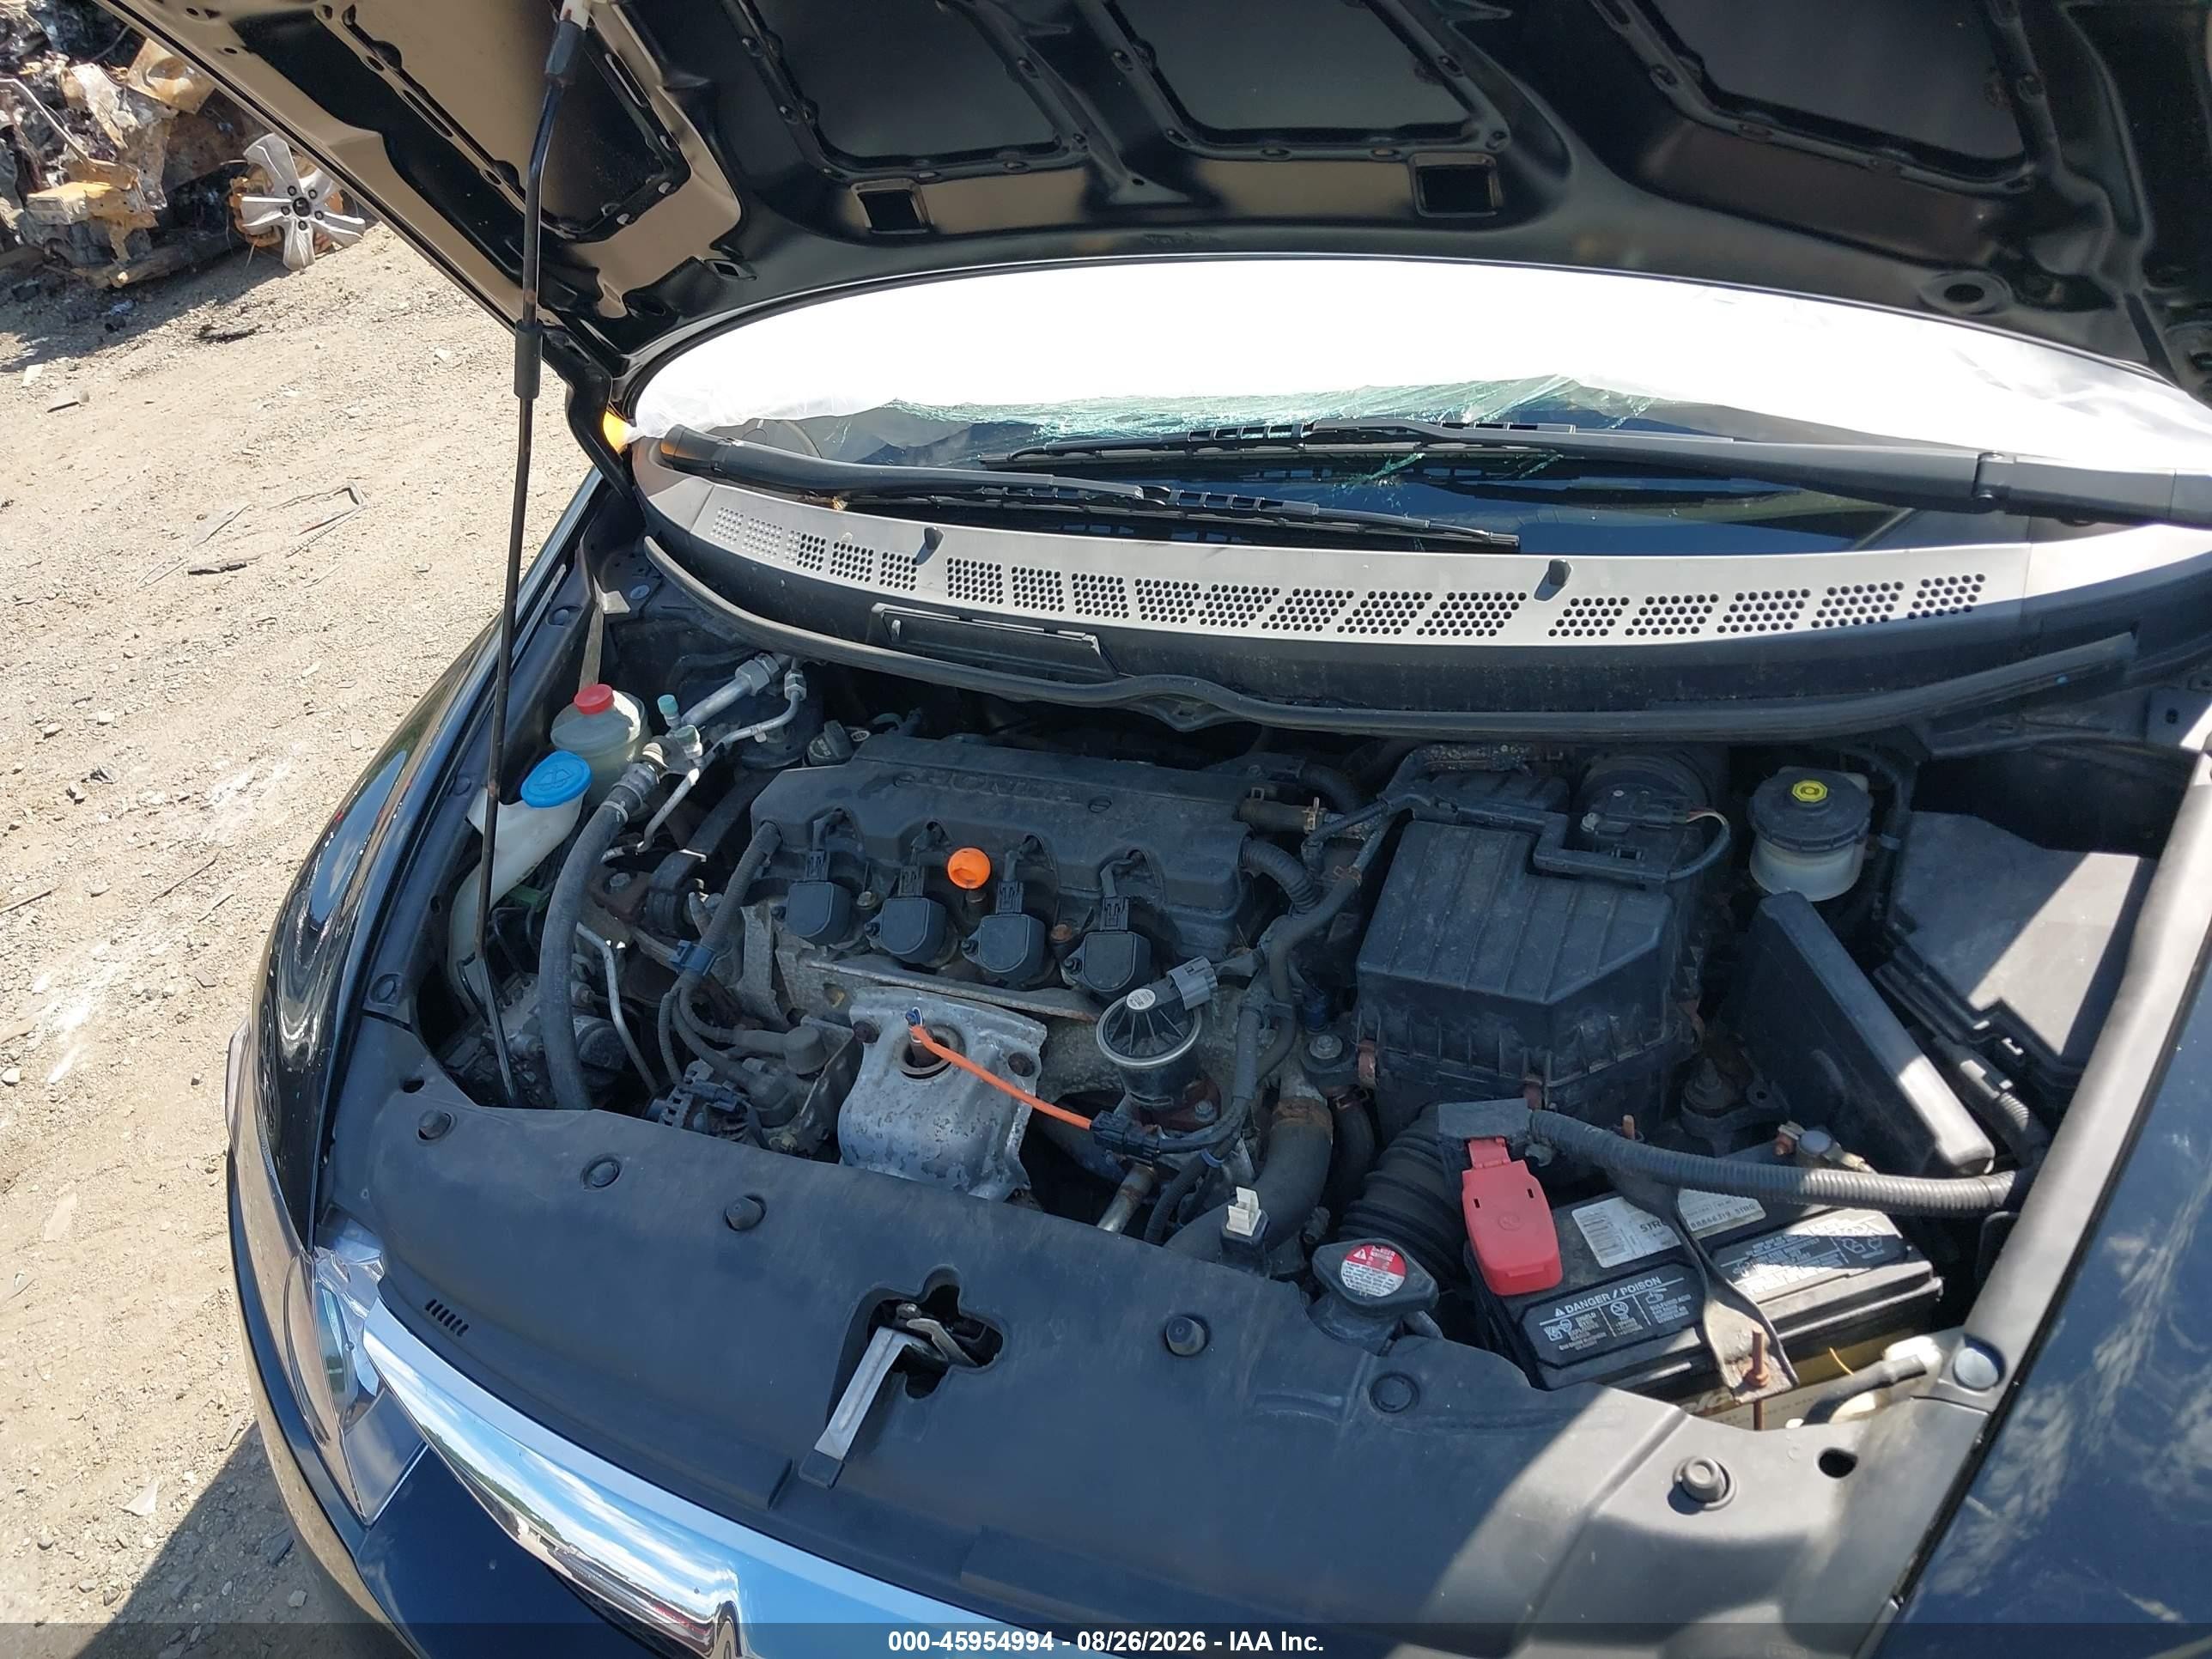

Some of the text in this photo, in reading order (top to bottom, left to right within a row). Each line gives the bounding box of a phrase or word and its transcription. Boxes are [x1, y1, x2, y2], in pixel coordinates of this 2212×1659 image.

[1565, 1277, 1662, 1314] DANGER / POISON
